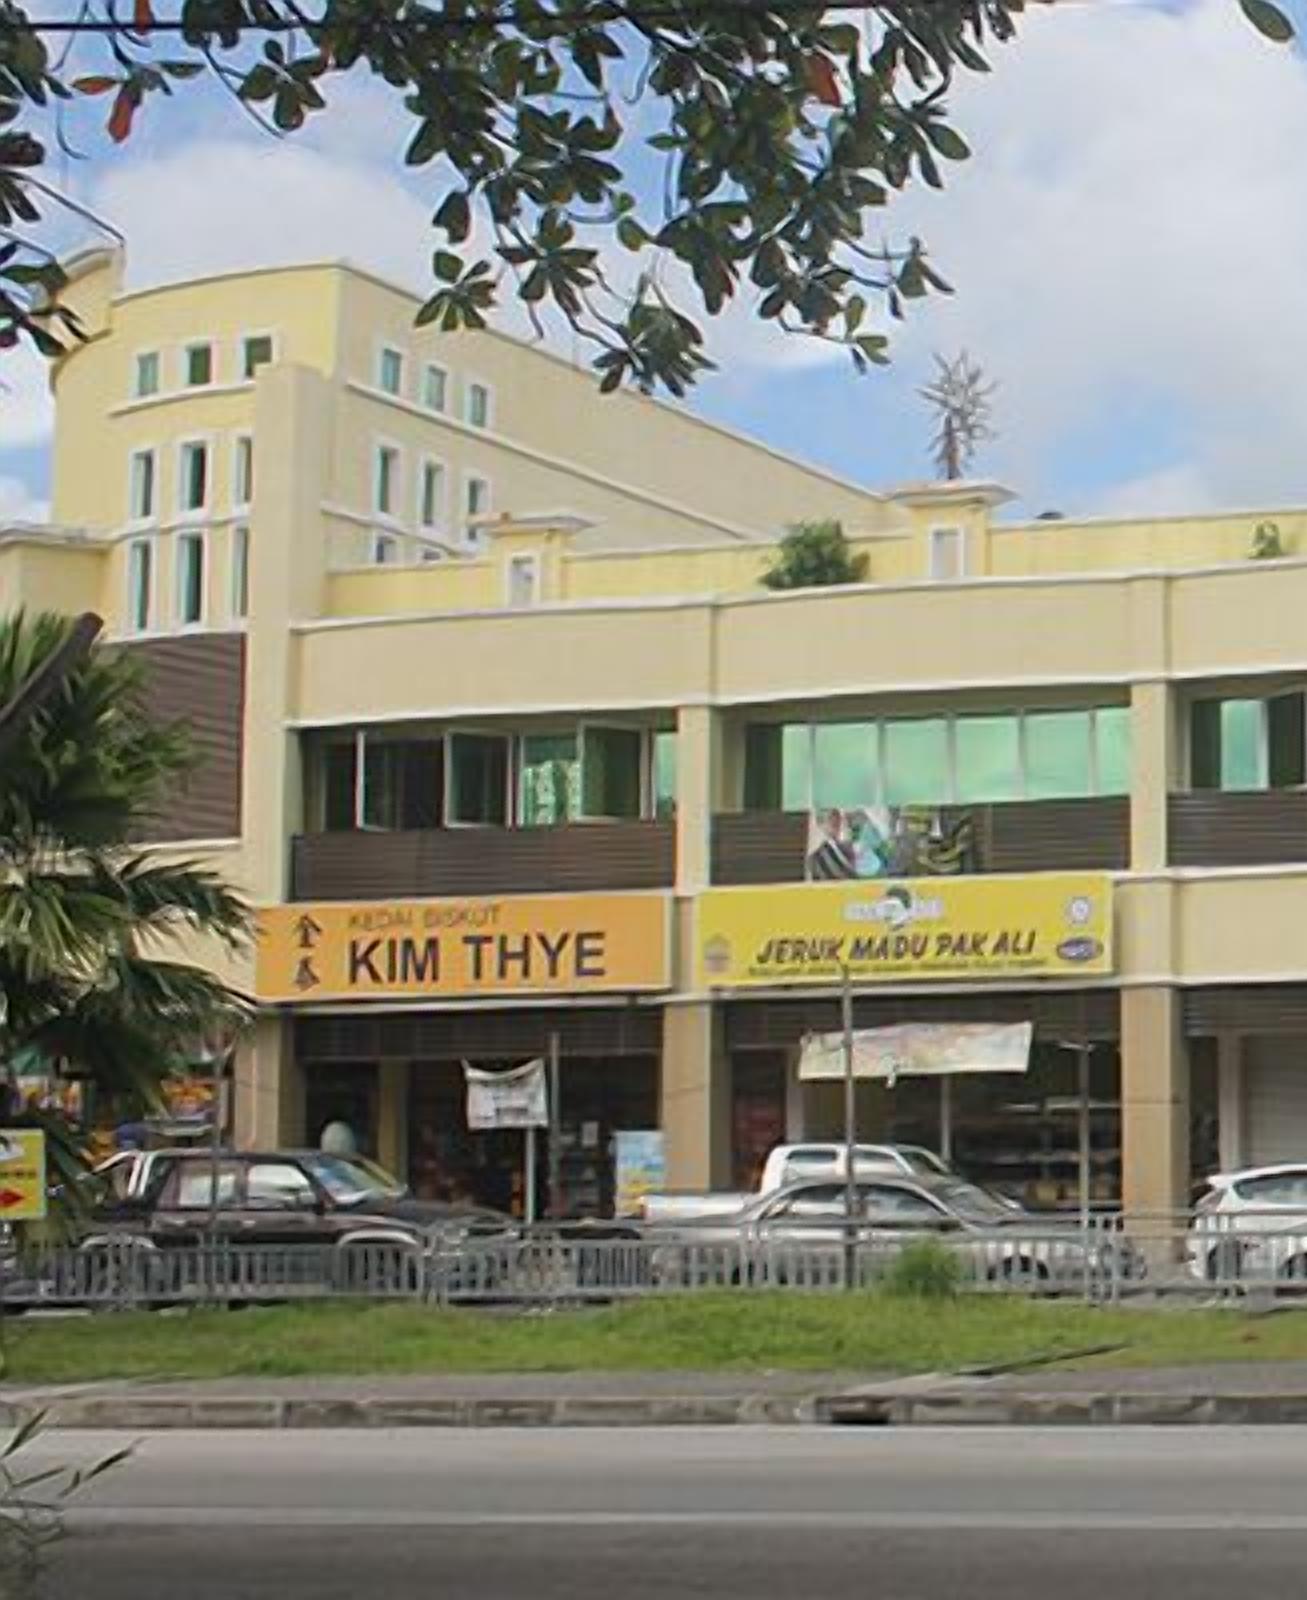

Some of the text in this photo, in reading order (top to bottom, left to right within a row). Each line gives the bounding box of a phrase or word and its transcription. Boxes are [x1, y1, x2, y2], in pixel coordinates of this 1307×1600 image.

[348, 904, 501, 931] KEDAI BISKUT
[347, 931, 606, 984] KIM THYE
[756, 937, 843, 964] JERUK
[847, 933, 925, 960] MADU
[933, 931, 988, 957] PAK
[991, 929, 1036, 954] ALI
